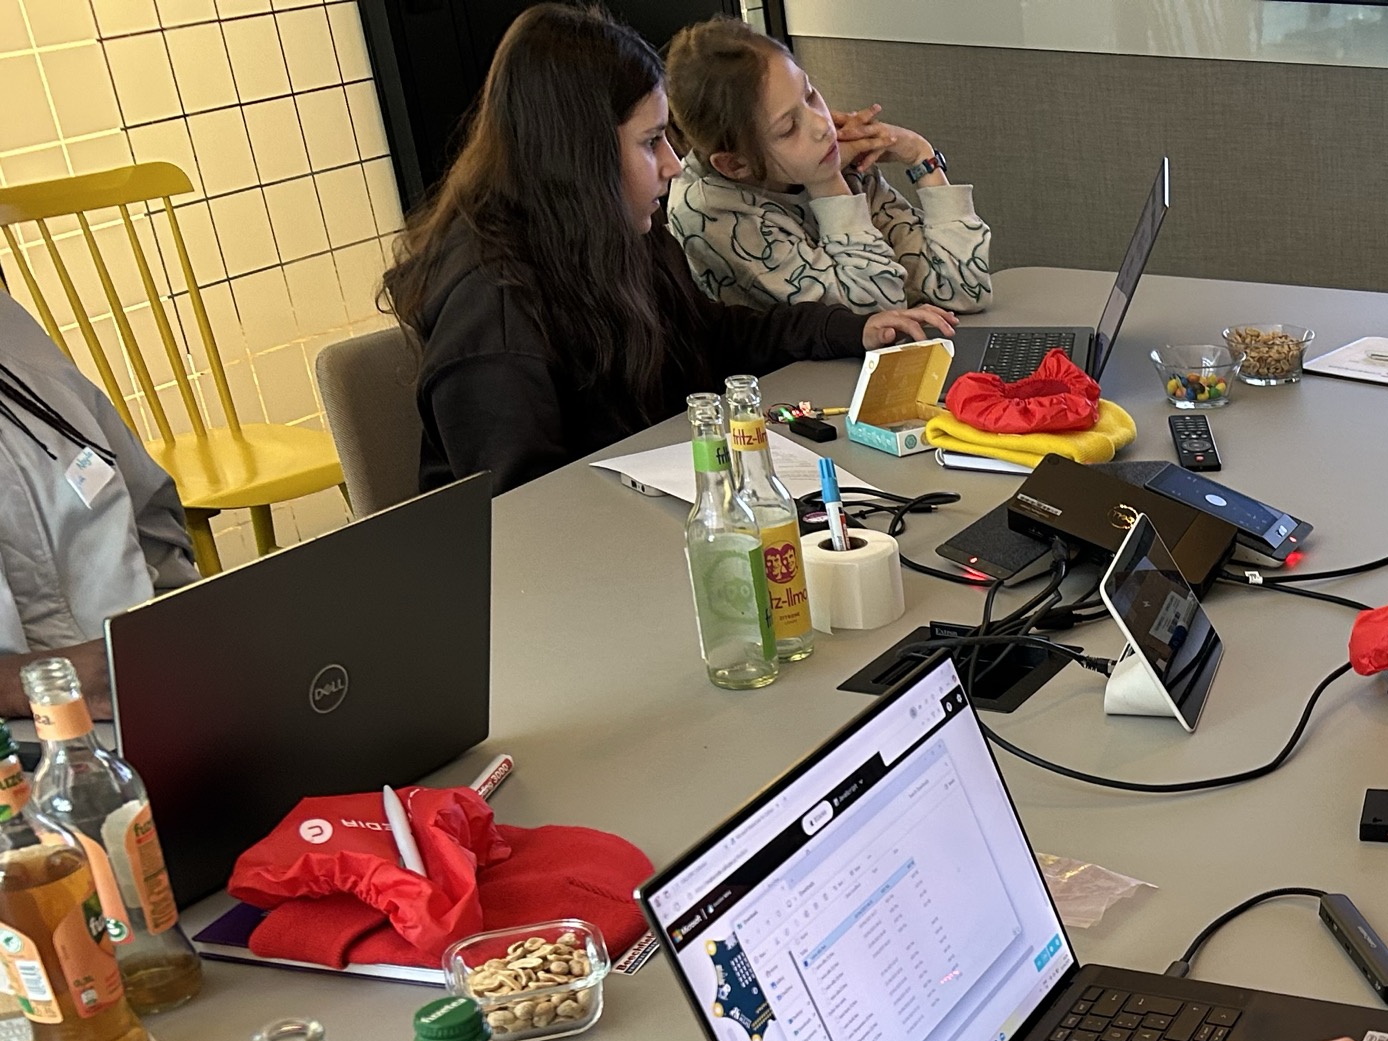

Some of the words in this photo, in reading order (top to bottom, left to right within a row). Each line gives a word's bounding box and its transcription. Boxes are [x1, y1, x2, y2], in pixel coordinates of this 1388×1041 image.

[314, 678, 345, 701] DELL
[491, 763, 509, 784] 3000
[679, 912, 703, 937] Microsoft
[420, 998, 467, 1024] fuzetea
